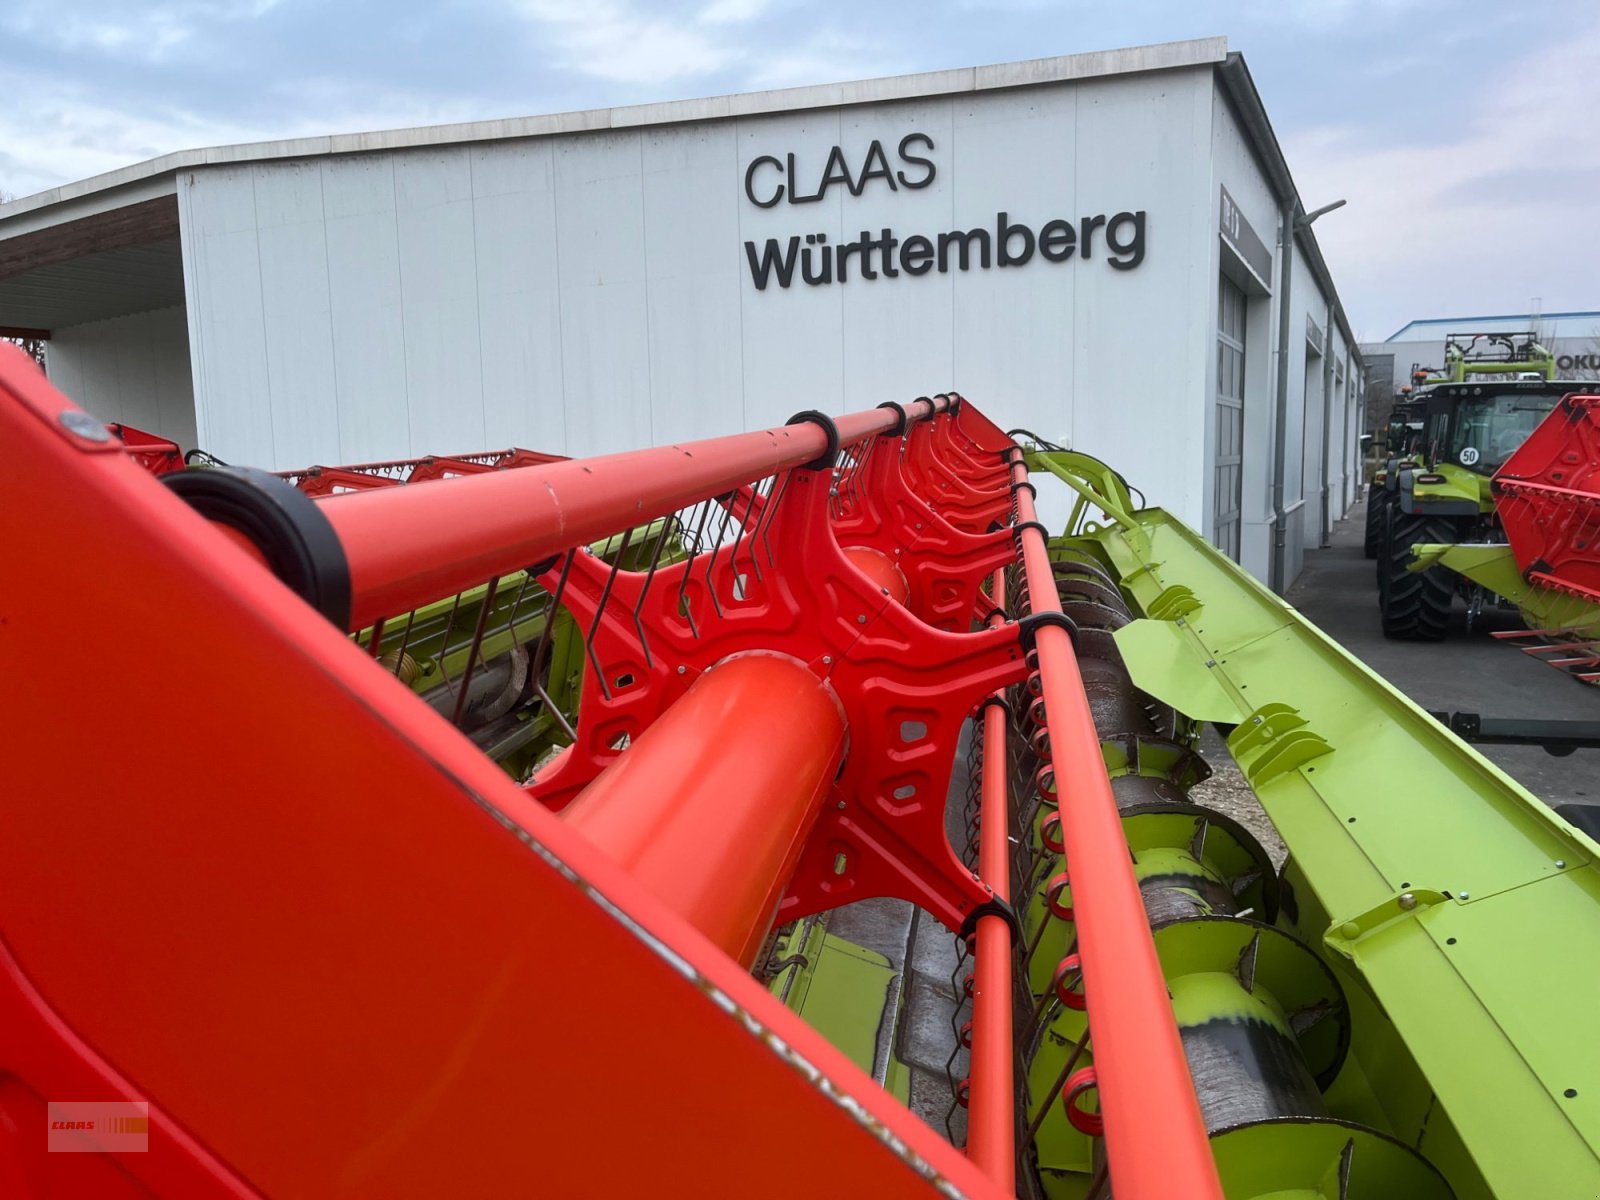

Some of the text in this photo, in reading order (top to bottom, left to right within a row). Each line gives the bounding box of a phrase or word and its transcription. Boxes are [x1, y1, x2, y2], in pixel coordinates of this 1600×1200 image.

[745, 133, 936, 208] CLAAS
[744, 211, 1146, 290] Württemberg
[1463, 450, 1476, 462] 50
